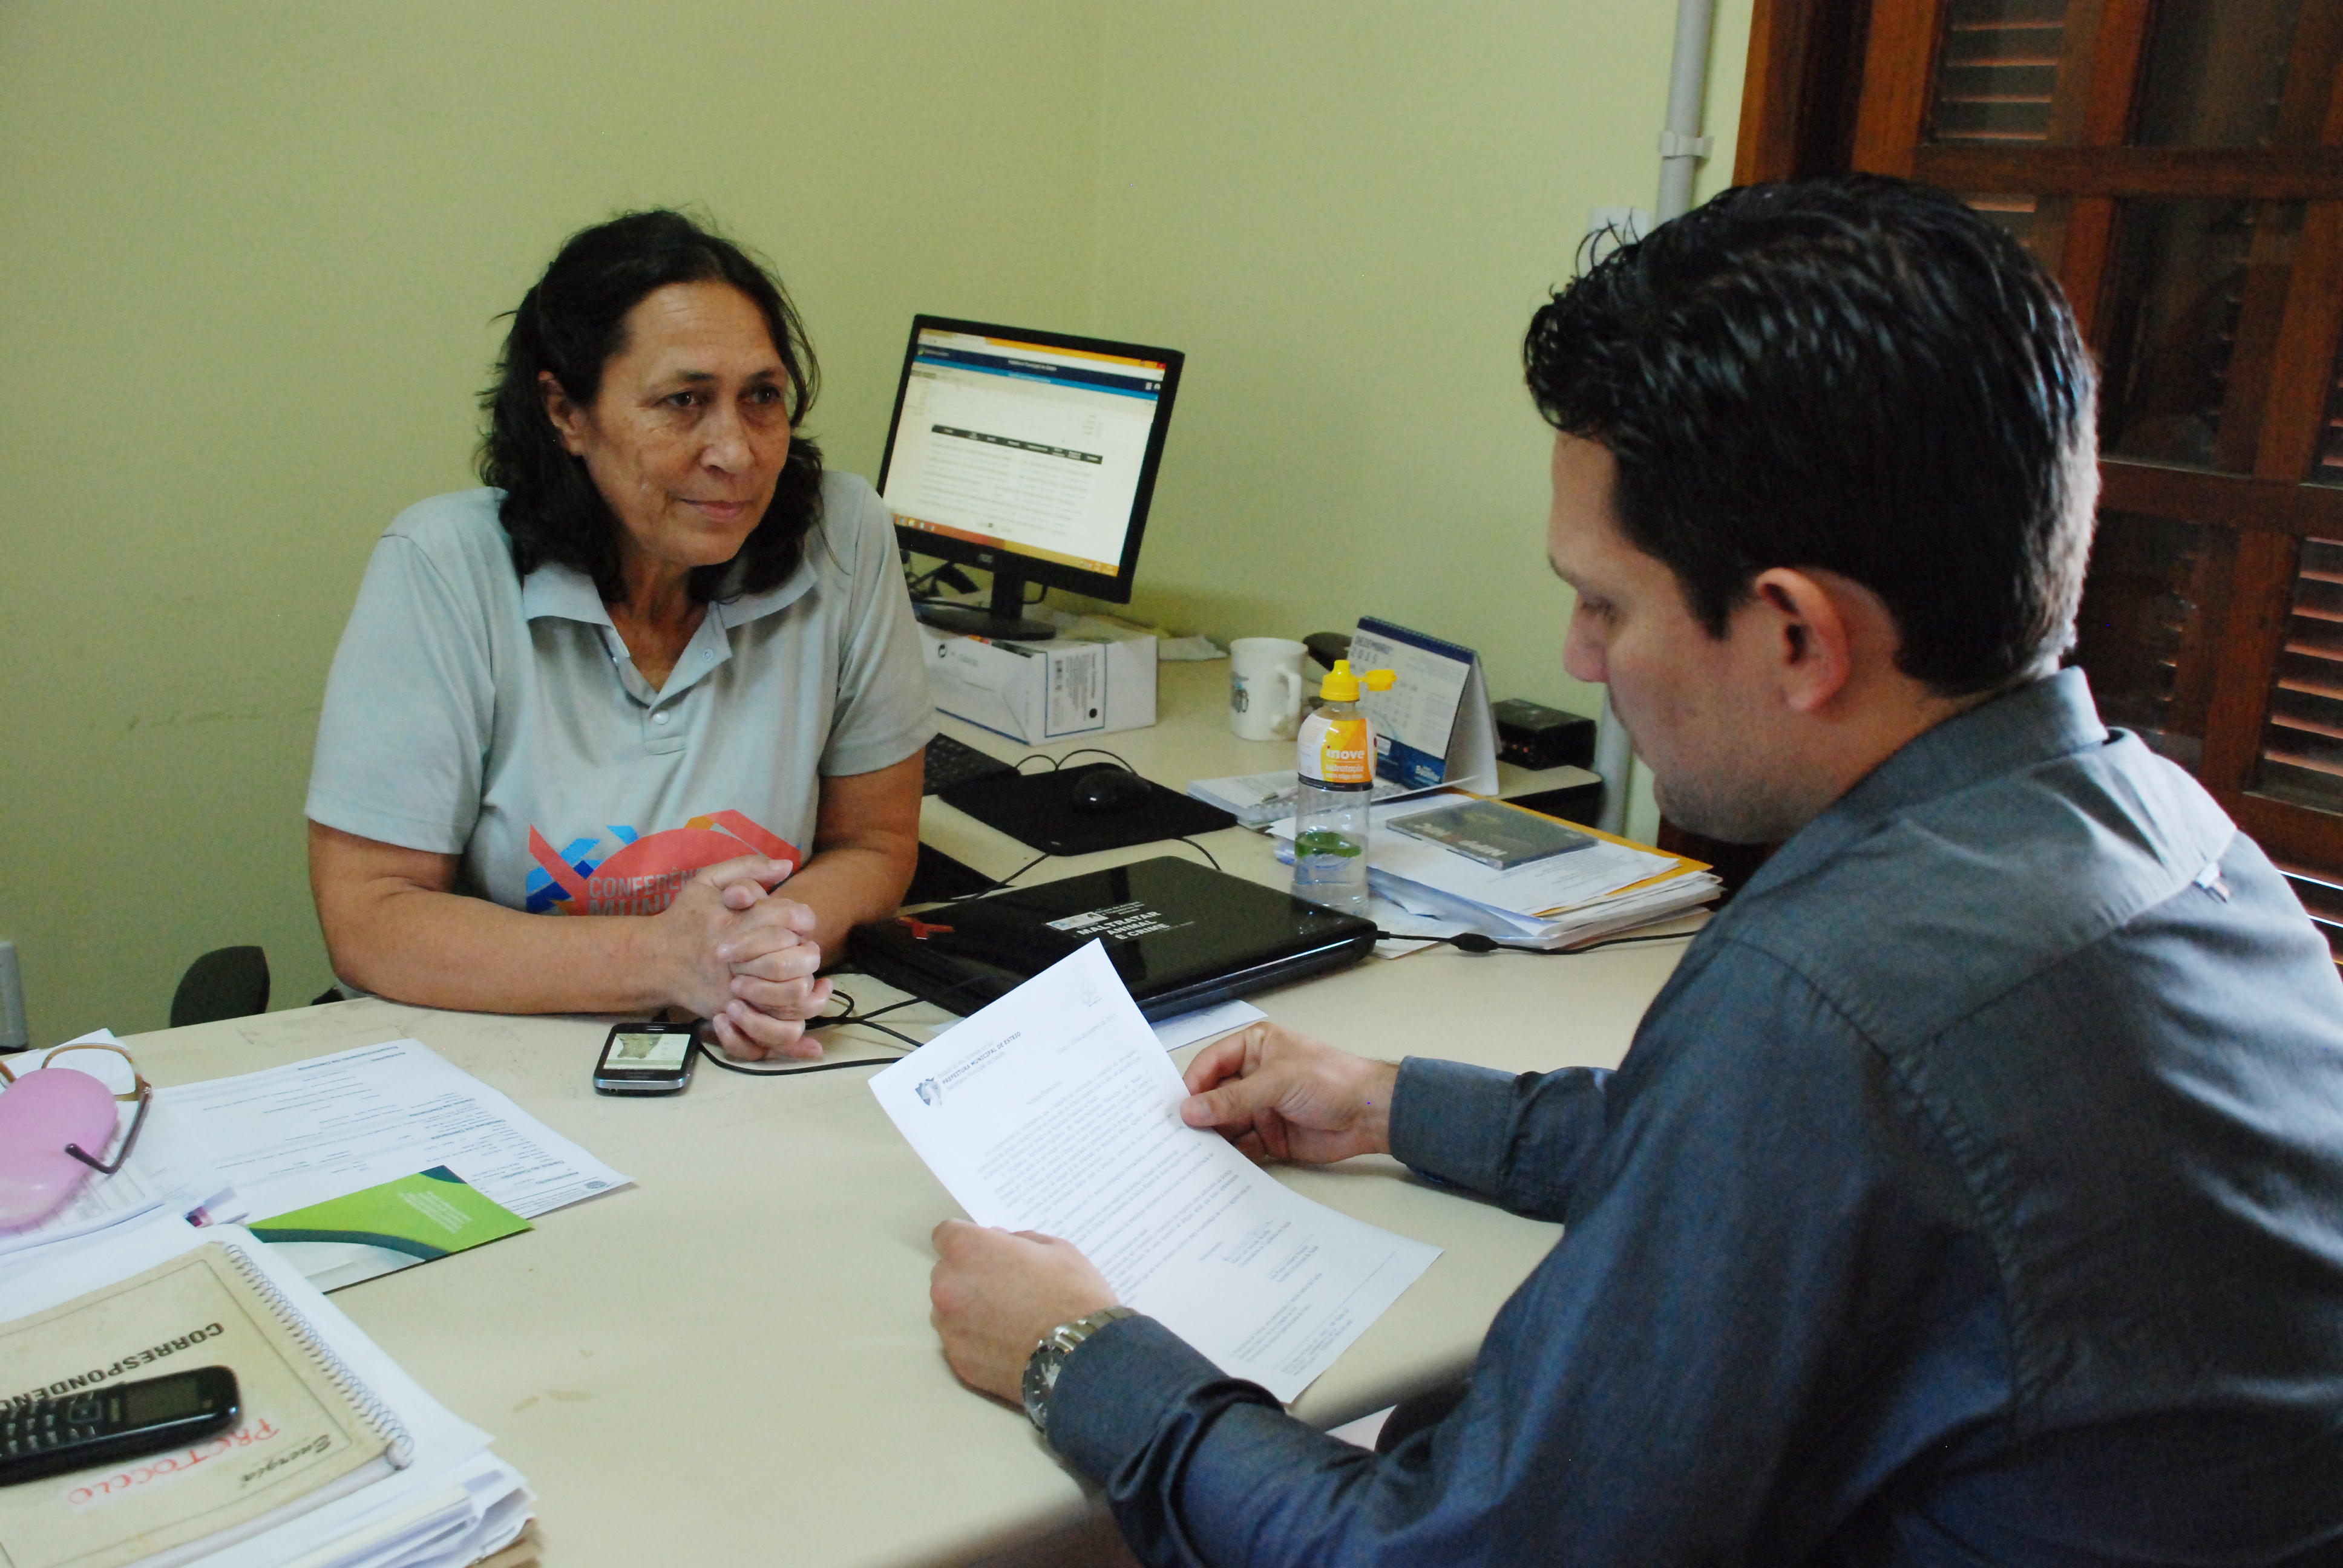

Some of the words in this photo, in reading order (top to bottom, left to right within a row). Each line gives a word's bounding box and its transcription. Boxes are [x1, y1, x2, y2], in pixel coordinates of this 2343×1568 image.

[589, 866, 702, 900] CONFERÊN
[1076, 912, 1161, 935] MALTRATAR
[1107, 920, 1157, 935] ANIMAL
[1127, 923, 1170, 936] CRIME
[942, 1063, 971, 1085] PREFEITURA
[970, 1047, 997, 1066] MUNICIPAL
[1003, 1031, 1021, 1044] ESTEIO
